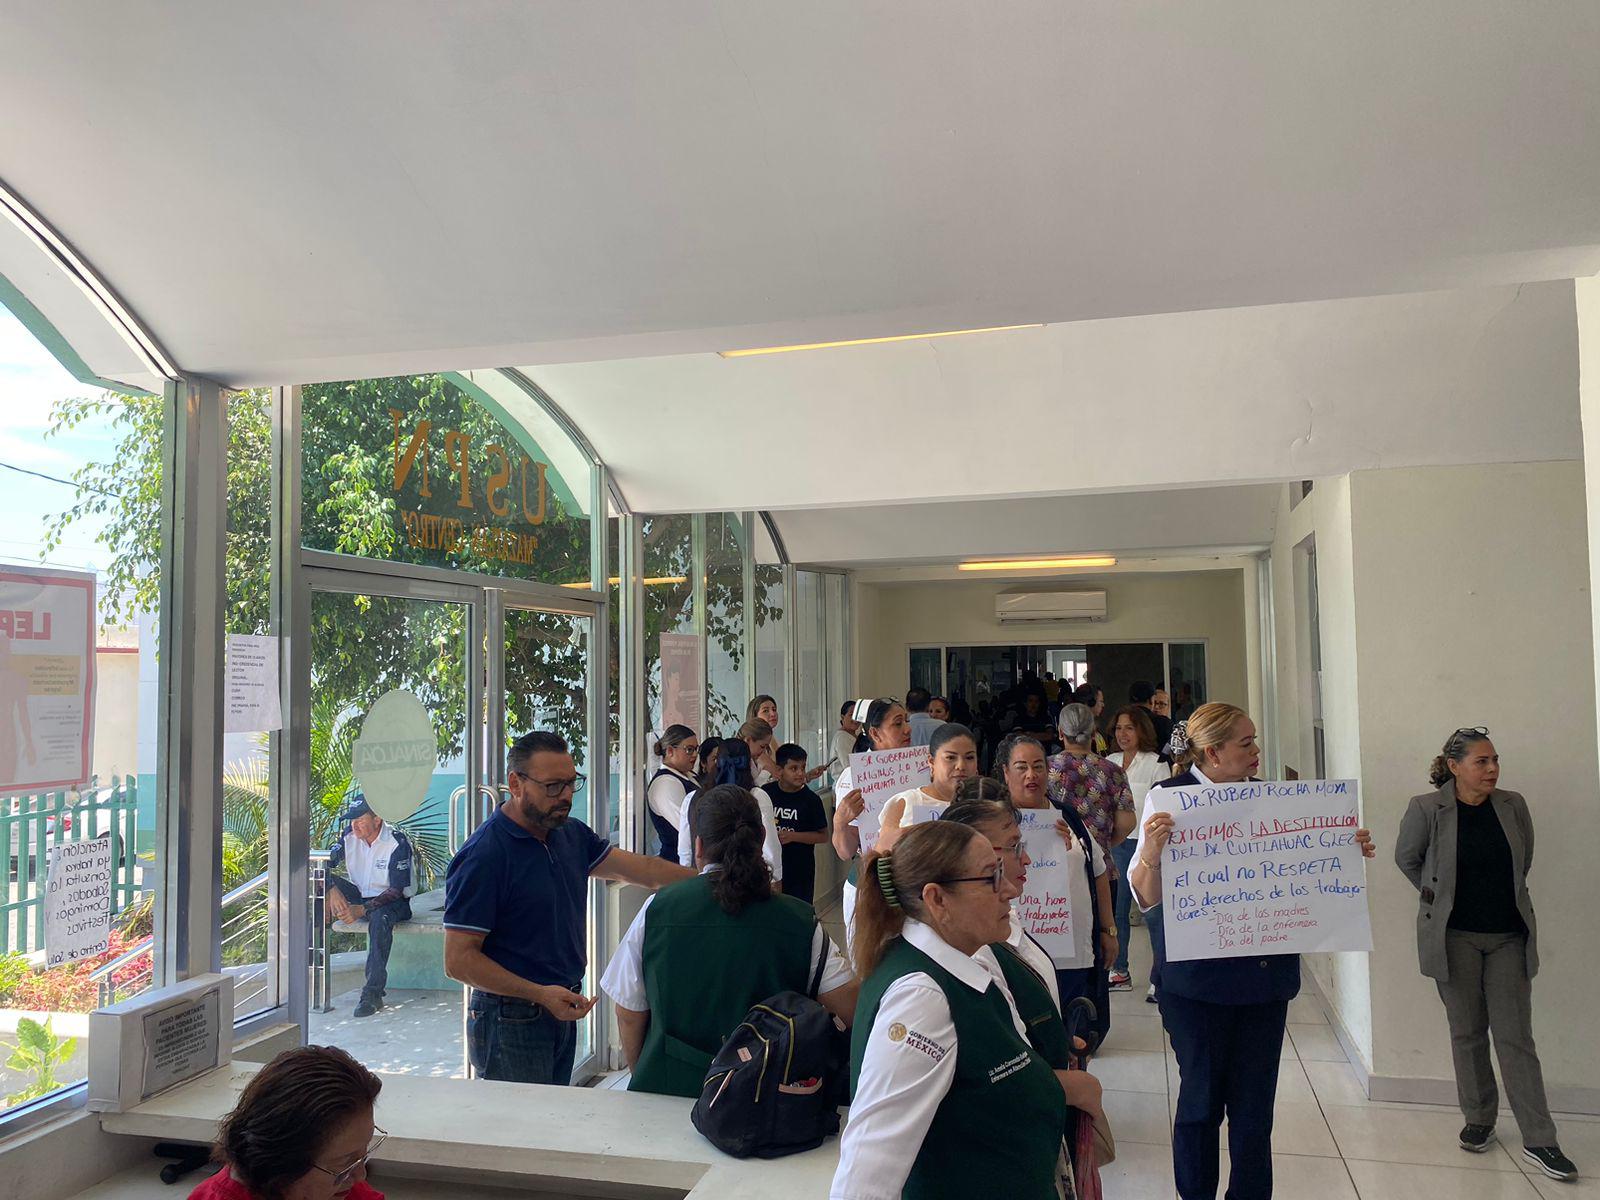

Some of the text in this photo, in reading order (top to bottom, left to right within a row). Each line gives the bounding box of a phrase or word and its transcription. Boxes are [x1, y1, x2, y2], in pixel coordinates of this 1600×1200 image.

[1201, 786, 1261, 806] RUBEN
[1263, 782, 1311, 801] ROCHA
[1316, 780, 1348, 798] MOYA
[1168, 821, 1244, 845] EXIGIMOS
[1250, 821, 1269, 838] LA
[1170, 847, 1200, 862] DEL
[1226, 834, 1314, 856] CUITLAHUAC
[1259, 856, 1342, 879] RESPETA
[1201, 888, 1265, 906] derechos
[1270, 885, 1285, 900] de
[1290, 883, 1310, 897] los
[1273, 903, 1310, 917] madres
[909, 1030, 939, 1049] GOBIERNO
